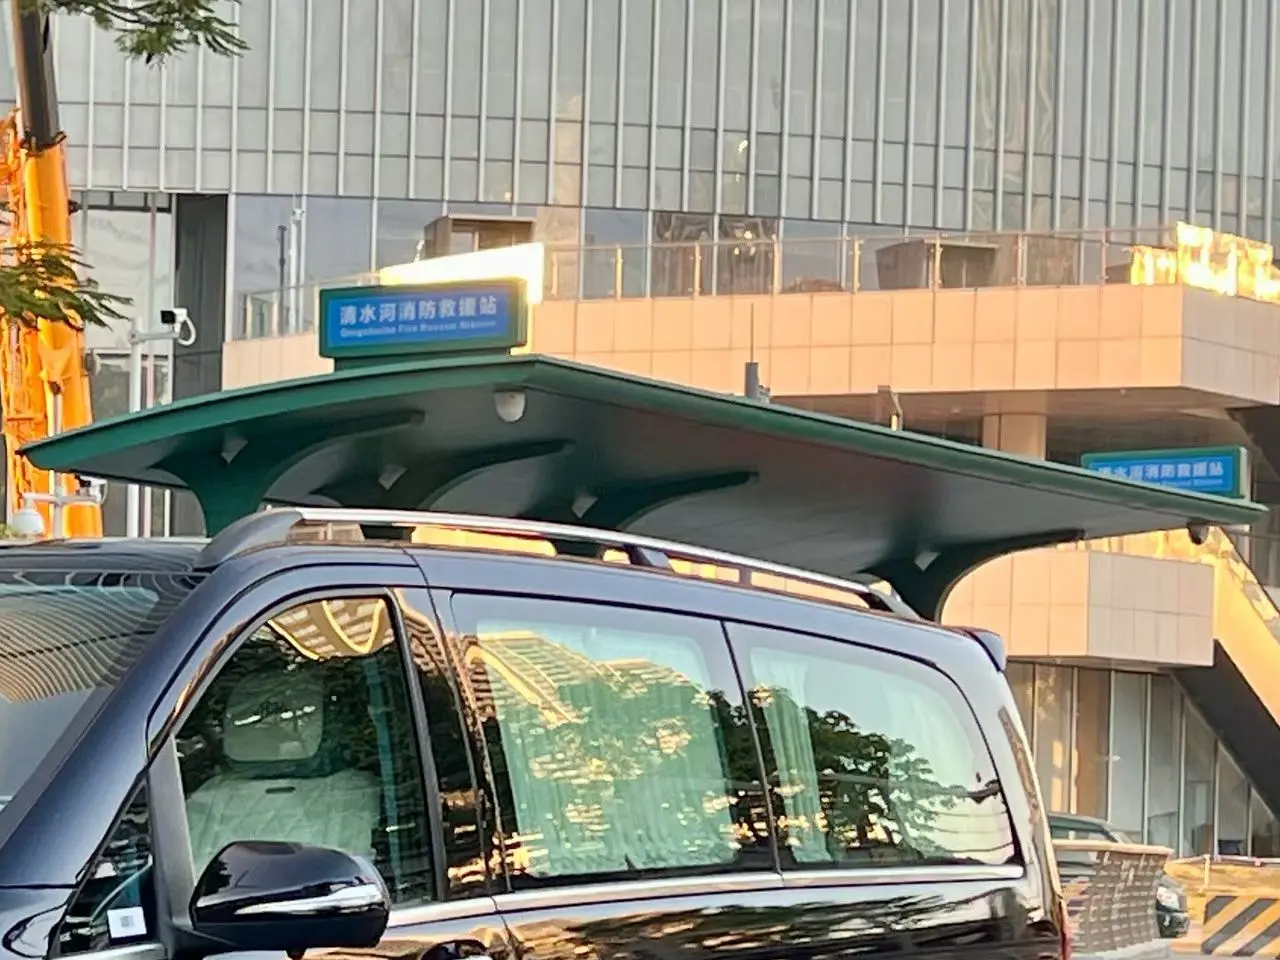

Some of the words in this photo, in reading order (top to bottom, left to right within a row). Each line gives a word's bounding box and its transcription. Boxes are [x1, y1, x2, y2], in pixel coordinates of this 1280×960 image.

[339, 296, 497, 325] 清水河消防救援站
